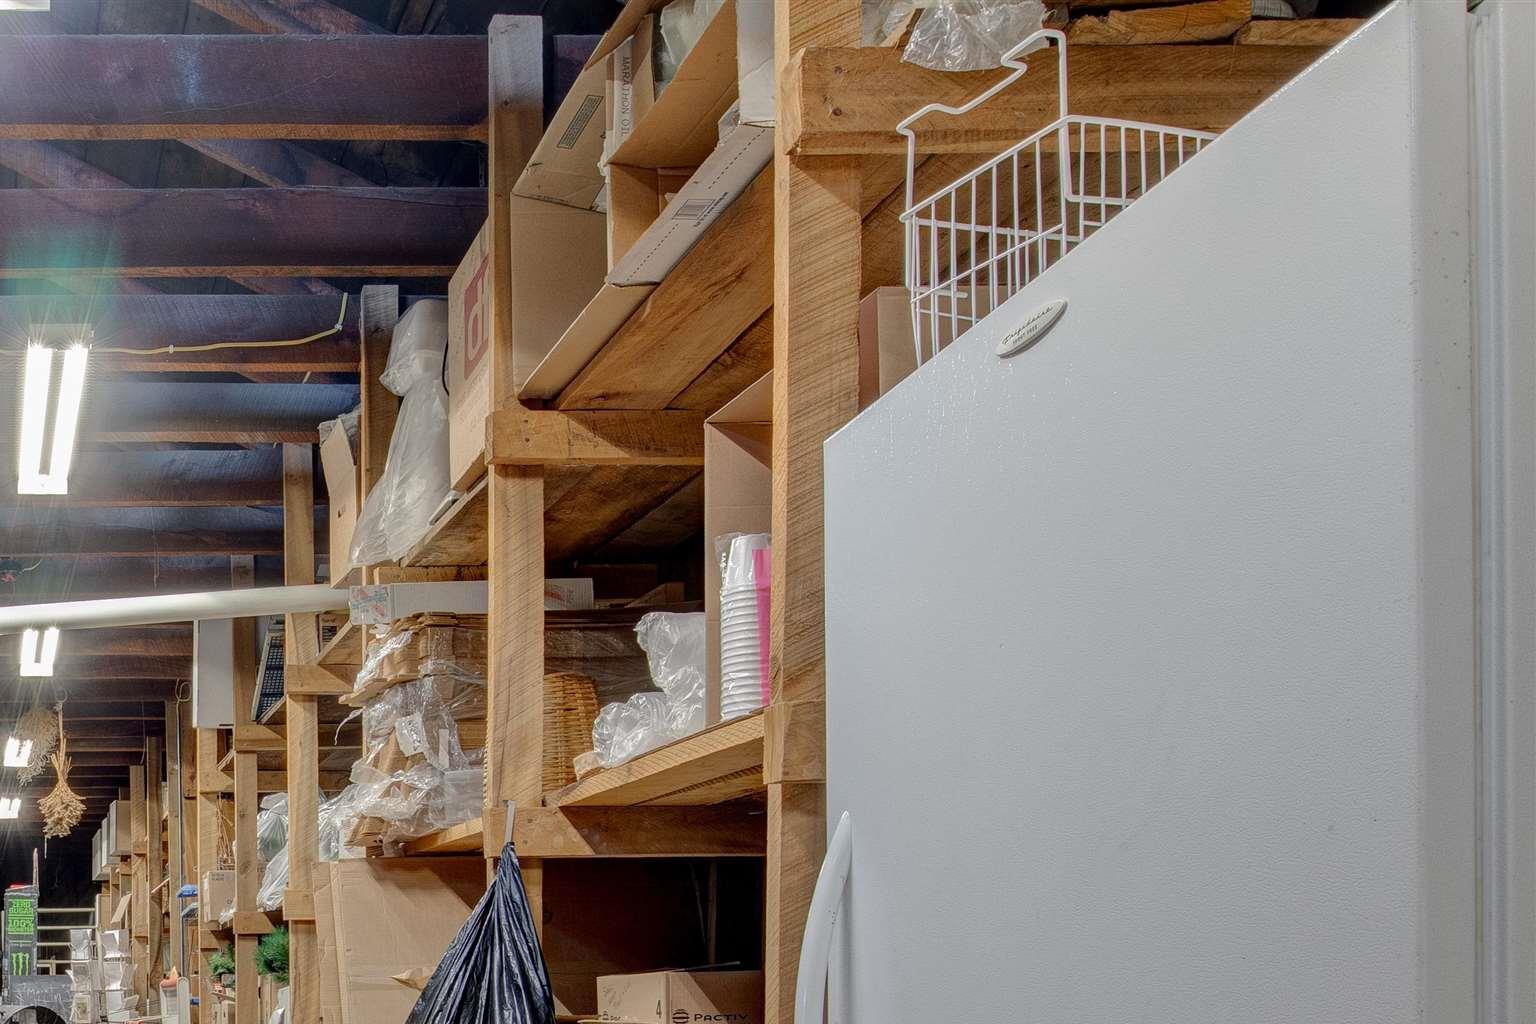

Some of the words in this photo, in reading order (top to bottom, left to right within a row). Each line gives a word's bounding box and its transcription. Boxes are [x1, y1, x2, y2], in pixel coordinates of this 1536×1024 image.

[620, 117, 631, 137] OIL
[9, 918, 33, 928] 100%
[656, 999, 663, 1019] 4
[694, 1013, 748, 1022] PACTIV
